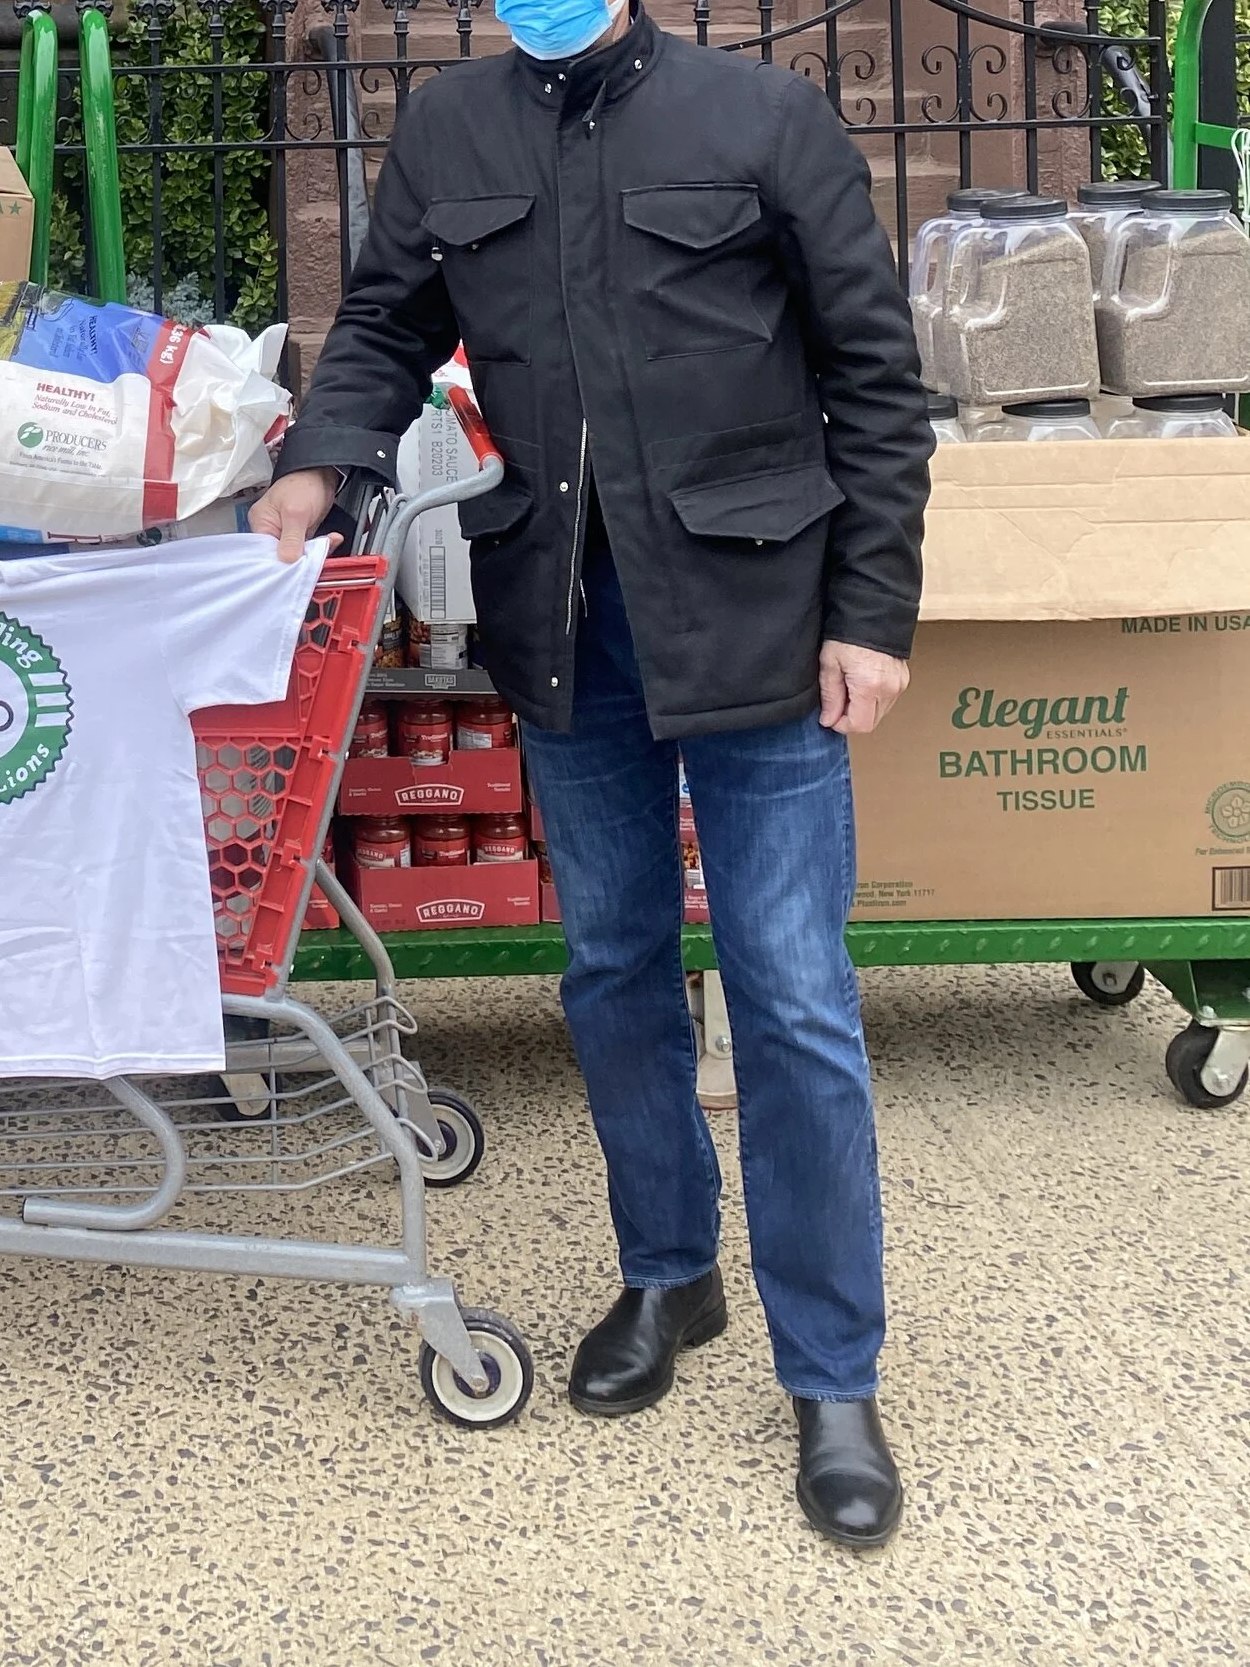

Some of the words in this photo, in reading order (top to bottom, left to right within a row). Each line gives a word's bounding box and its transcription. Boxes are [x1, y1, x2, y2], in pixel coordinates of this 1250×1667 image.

[36, 382, 95, 402] HEALTHY!
[32, 402, 60, 413] Sodium
[45, 429, 107, 451] PRODUCERS
[431, 441, 444, 476] B20203
[1121, 616, 1181, 634] MADE
[1188, 615, 1208, 632] IN
[951, 686, 1130, 740] Elegant
[939, 745, 1148, 778] BATHROOM
[402, 788, 458, 802] REGGANO
[996, 788, 1095, 812] TISSUE
[423, 903, 478, 918] REGGANO
